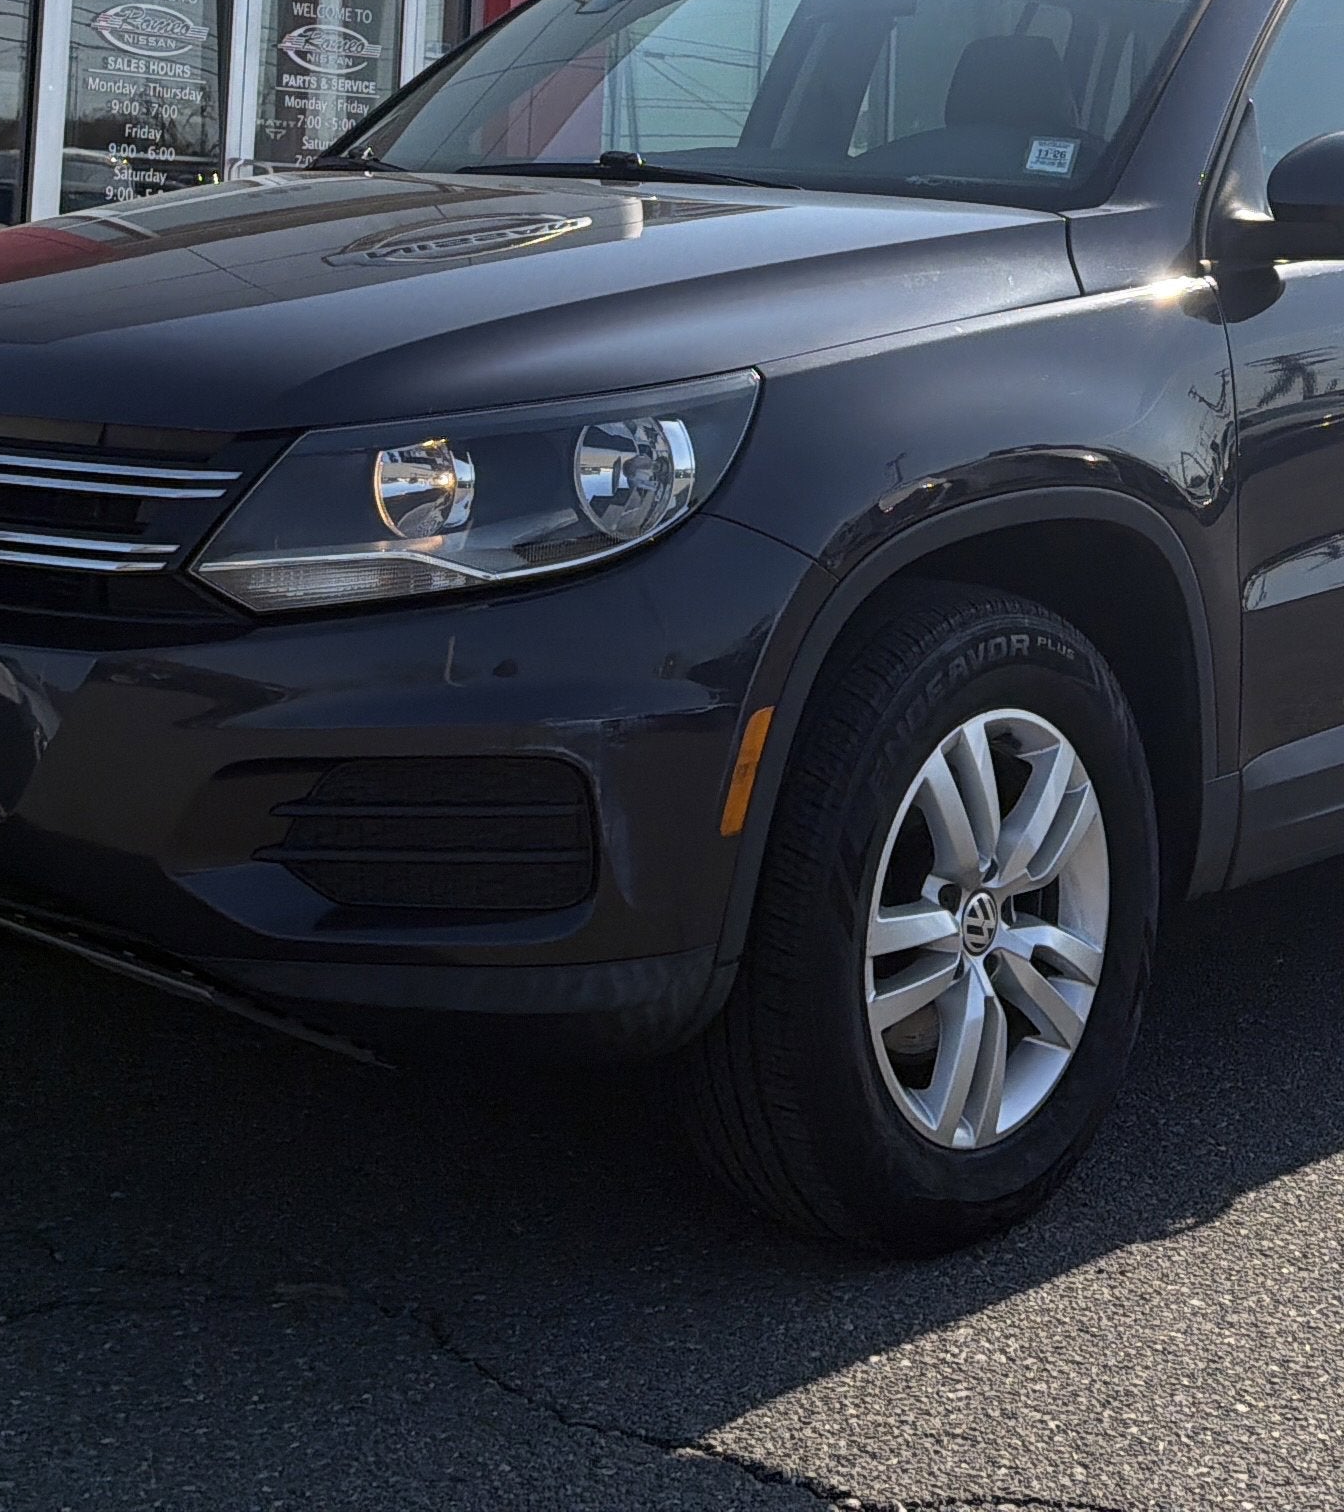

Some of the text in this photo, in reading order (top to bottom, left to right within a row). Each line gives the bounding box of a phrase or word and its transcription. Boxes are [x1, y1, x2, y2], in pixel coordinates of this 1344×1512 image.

[113, 6, 191, 36] Romeo
[292, 2, 372, 24] WELCOME TO
[124, 34, 176, 49] NISSAN
[299, 28, 365, 53] Romeo
[108, 56, 191, 77] SALES HOURS
[306, 53, 353, 67] NISSAN
[88, 77, 136, 97] Monday
[148, 82, 203, 104] Thursday
[282, 74, 376, 94] PARTS & SERVICE
[111, 99, 139, 116] 9:00
[151, 103, 178, 119] 7:00
[284, 95, 328, 113] Monday
[337, 99, 370, 117] Friday
[297, 115, 322, 130] 7:00
[125, 123, 162, 143] Friday
[108, 143, 136, 157] 9:00
[148, 147, 176, 161] 6:00
[113, 165, 167, 186] Saturday
[106, 185, 134, 202] 9:00
[1037, 635, 1076, 661] PLUS
